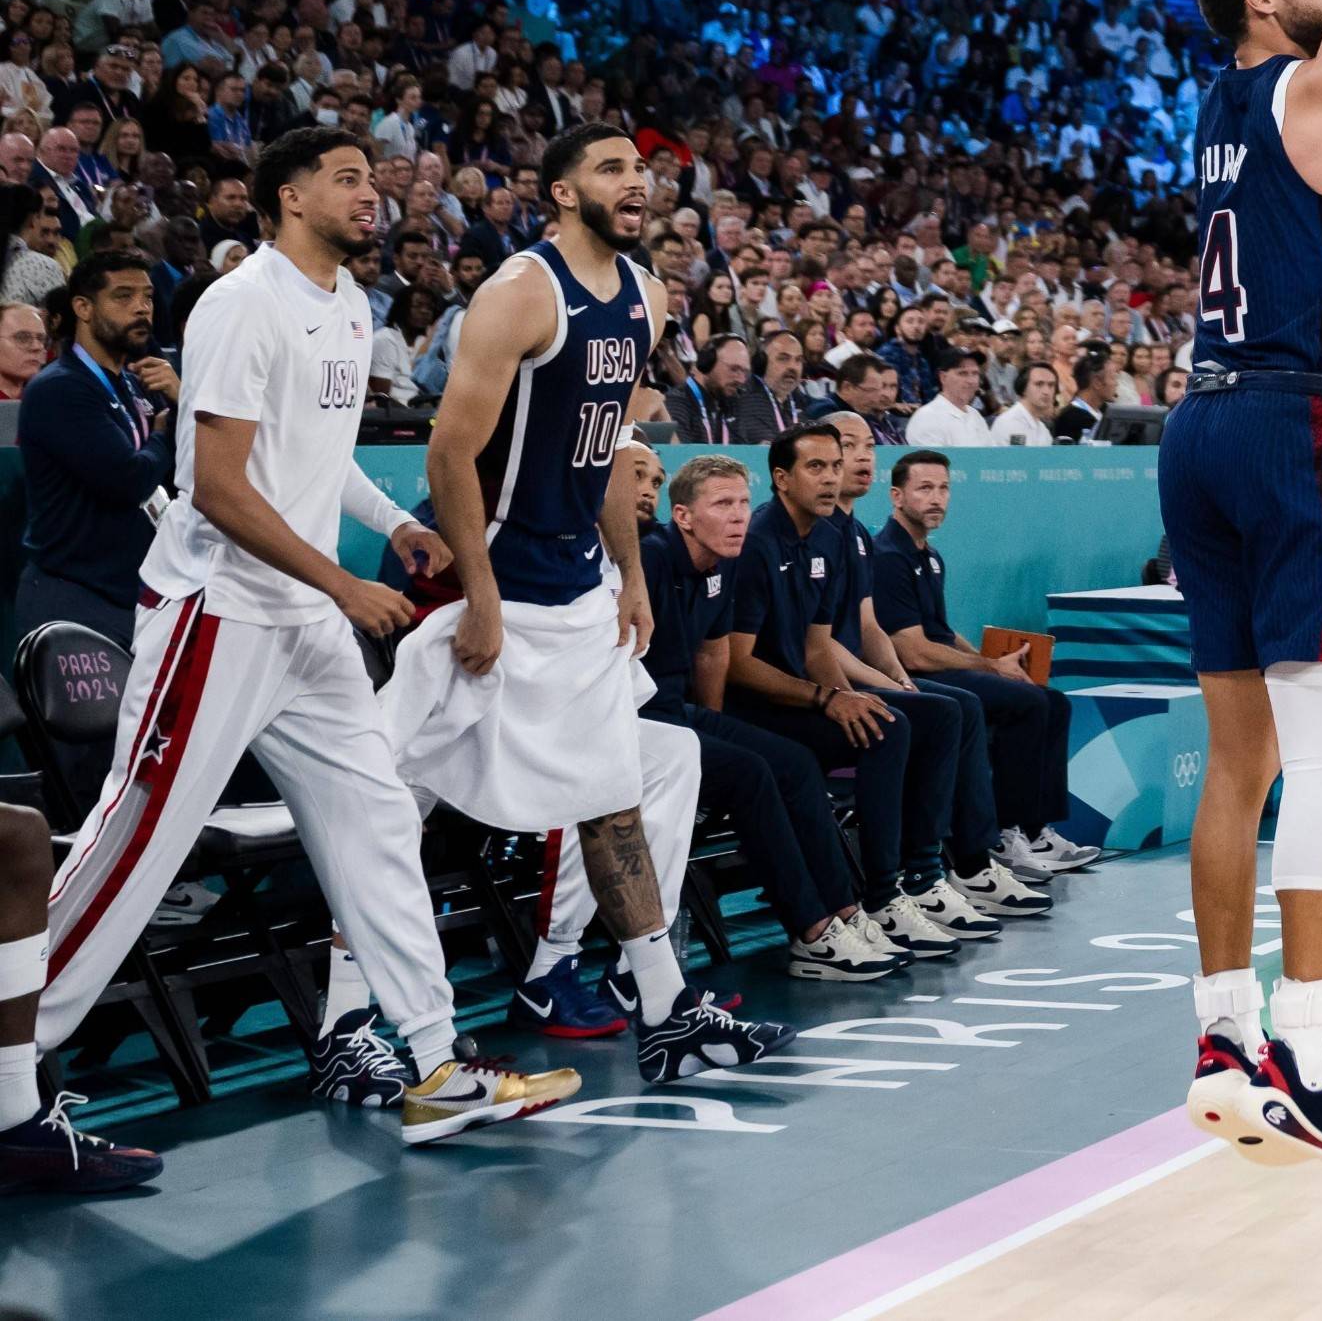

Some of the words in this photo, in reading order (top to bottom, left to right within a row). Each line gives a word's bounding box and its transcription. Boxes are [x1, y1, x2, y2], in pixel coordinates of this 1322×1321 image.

[1200, 208, 1248, 343] 4
[319, 360, 359, 409] USA
[586, 336, 636, 386] USA
[571, 400, 622, 468] 10
[65, 677, 119, 703] 2024
